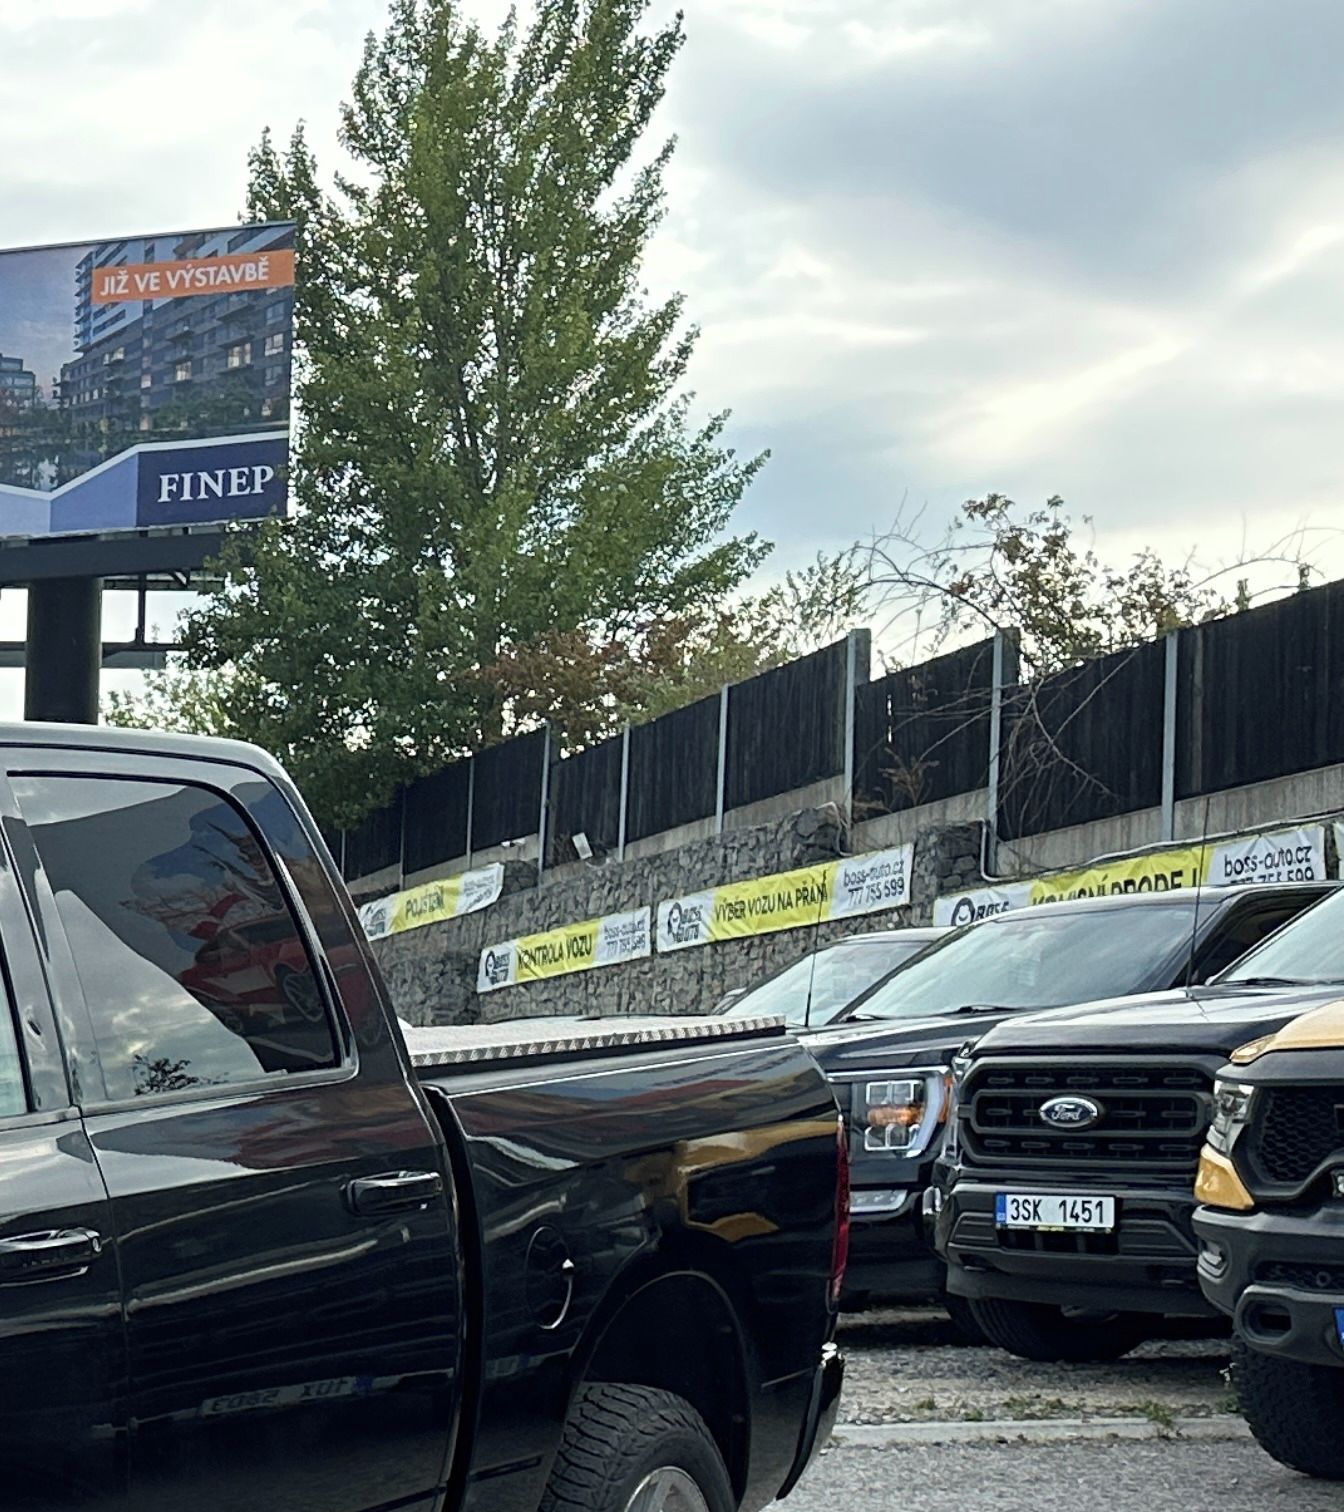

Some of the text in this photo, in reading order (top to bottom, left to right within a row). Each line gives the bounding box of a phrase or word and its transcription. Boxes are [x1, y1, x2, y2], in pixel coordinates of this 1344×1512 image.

[99, 255, 270, 296] JIŽ VE VÝSTAVBĚ
[156, 465, 274, 503] FINEP
[1224, 845, 1312, 878] boss-auto.cz
[748, 894, 776, 917] VOZU
[777, 890, 793, 912] NA
[1051, 1103, 1081, 1121] Ford
[1010, 1198, 1043, 1222] 3SK
[1058, 1199, 1104, 1224] 1451
